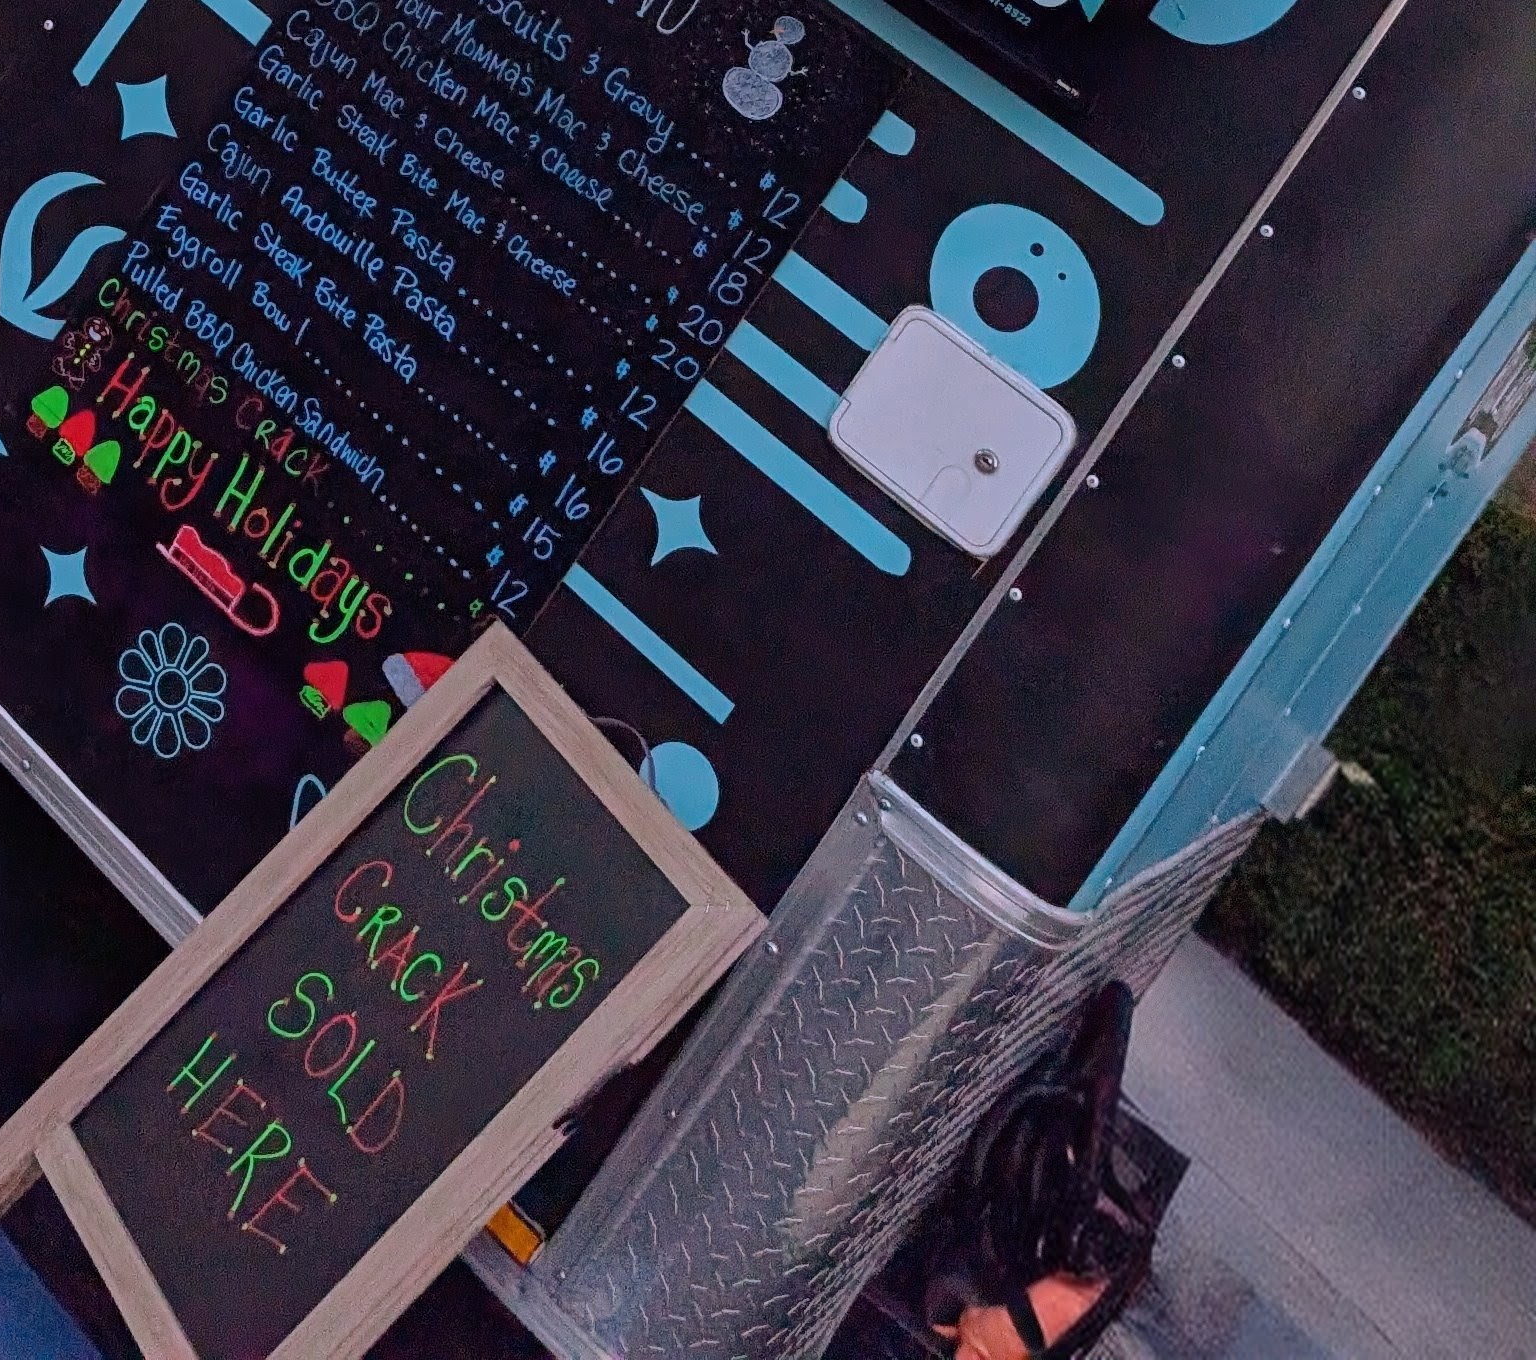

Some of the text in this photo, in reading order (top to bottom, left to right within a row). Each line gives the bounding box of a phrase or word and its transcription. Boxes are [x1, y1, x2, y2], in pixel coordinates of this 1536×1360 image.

[234, 86, 298, 152] Garlic
[390, 207, 456, 282] Pasta
[615, 358, 657, 431] $12
[258, 44, 324, 111] Garlic
[399, 153, 438, 197] Bite
[443, 189, 486, 235] Mac
[507, 234, 577, 297] Cheese
[645, 314, 700, 381] $20
[286, 9, 358, 80] Cajun
[361, 69, 405, 119] Mac
[433, 126, 505, 189] Cheese
[667, 286, 723, 346] $20
[471, 94, 520, 145] Mac
[541, 147, 613, 212] Cheese
[692, 239, 748, 306] $18
[533, 87, 587, 141] Mac
[618, 148, 705, 226] Cheese
[727, 208, 772, 275] $12
[603, 67, 675, 155] Gravy
[759, 171, 801, 230] $12
[98, 277, 229, 405] Christmas
[121, 240, 184, 313] Pulled
[184, 299, 234, 357] BBQ
[294, 397, 385, 494] Sandwich
[485, 545, 529, 619] $12
[155, 204, 562, 560] Eggroll Bowl $15
[179, 161, 243, 231] Garlic
[314, 276, 357, 329] Bite
[362, 313, 418, 385] Pasta
[538, 450, 590, 521] $16
[207, 123, 624, 475] Cajun Andouille Pasta $16
[95, 353, 395, 644] Happy Holidays
[334, 859, 484, 1061] CRACK
[402, 753, 602, 1011] Christmas
[166, 1030, 338, 1255] HERE
[266, 970, 406, 1155] SOLD
